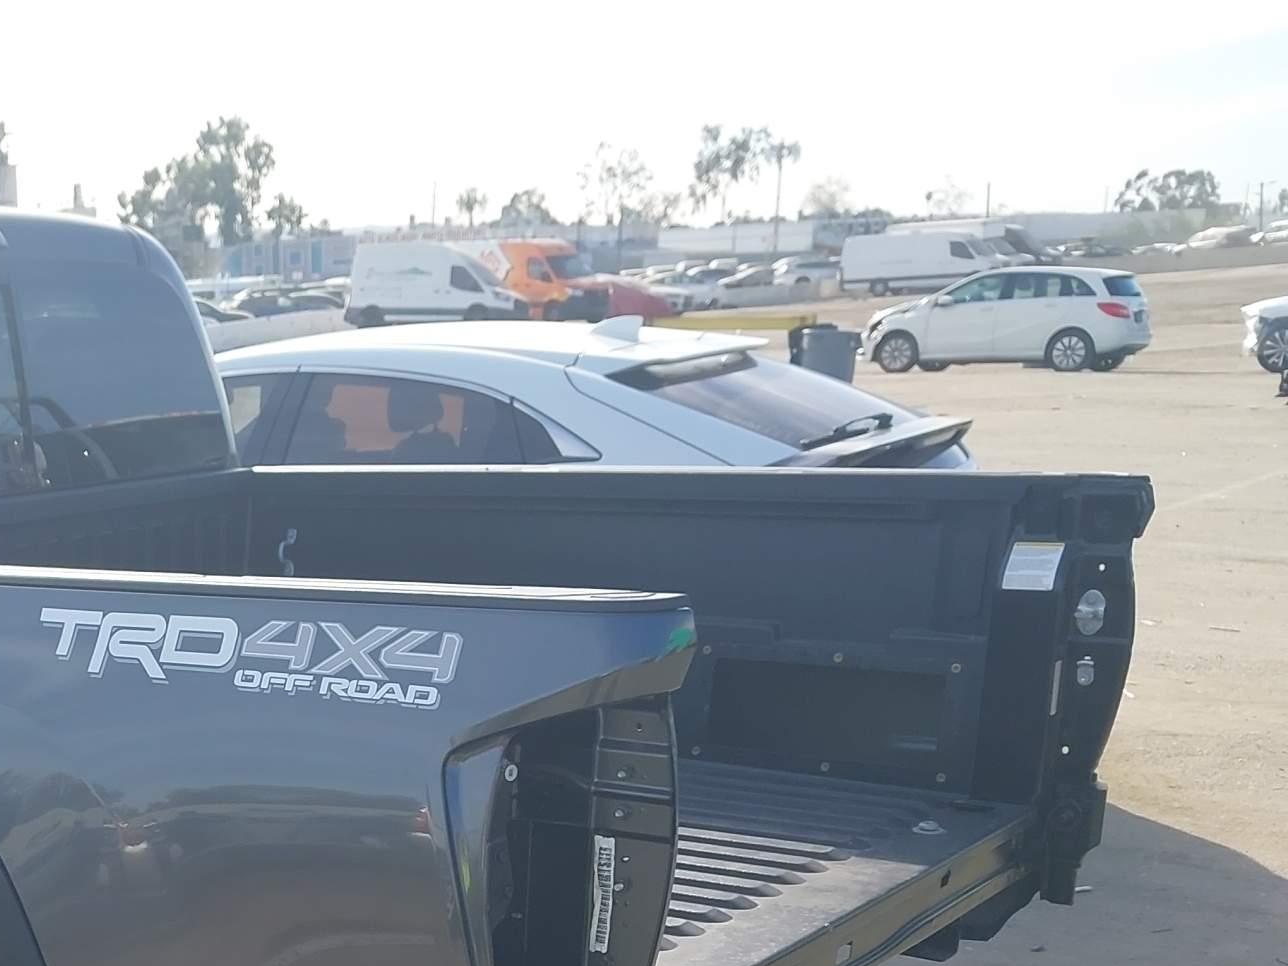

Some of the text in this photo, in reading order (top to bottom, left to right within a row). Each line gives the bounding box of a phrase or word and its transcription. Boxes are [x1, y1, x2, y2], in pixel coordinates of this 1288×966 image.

[40, 607, 242, 684] TRD
[233, 668, 441, 711] OFF ROAD
